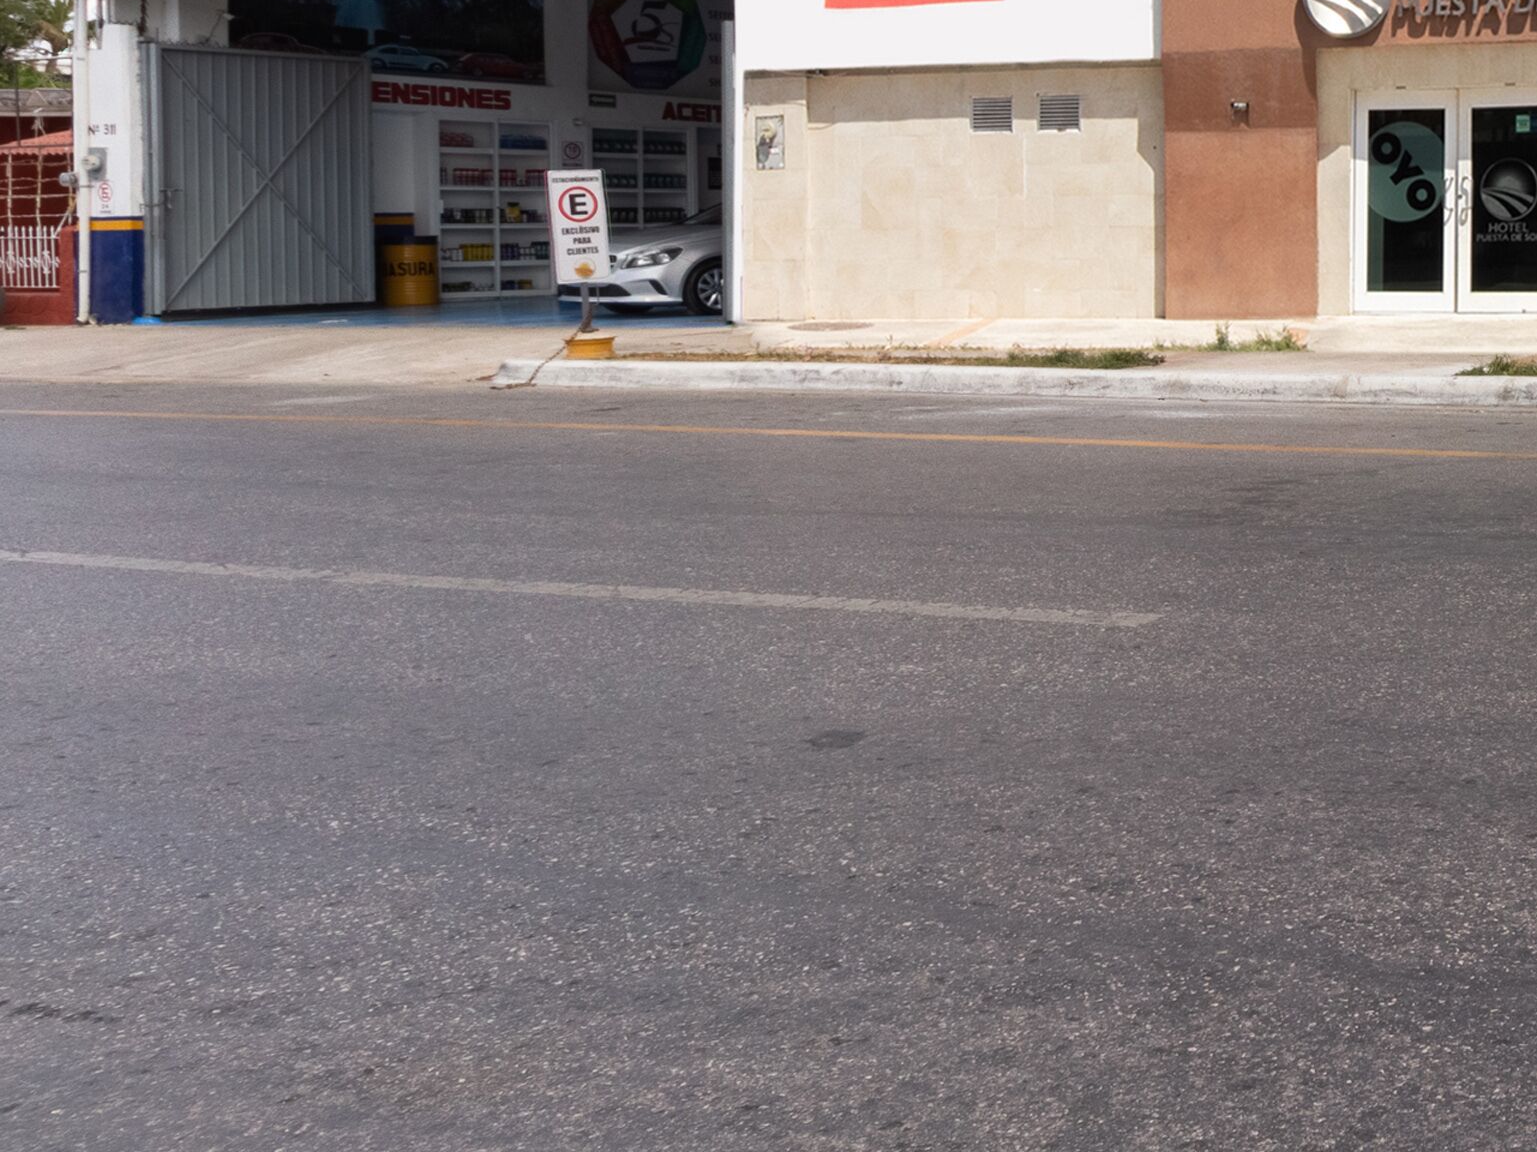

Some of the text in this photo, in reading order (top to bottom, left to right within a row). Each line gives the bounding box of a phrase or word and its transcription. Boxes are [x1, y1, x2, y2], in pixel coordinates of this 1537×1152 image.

[103, 124, 117, 136] 311
[1371, 132, 1436, 211] OYO
[568, 193, 588, 216] E
[562, 225, 600, 236] EXCLUSIVO
[1488, 222, 1529, 233] HOTEL
[573, 236, 592, 245] PARA
[1476, 233, 1509, 242] PUESTA
[1511, 233, 1522, 242] DE
[566, 245, 599, 256] CLIENTES
